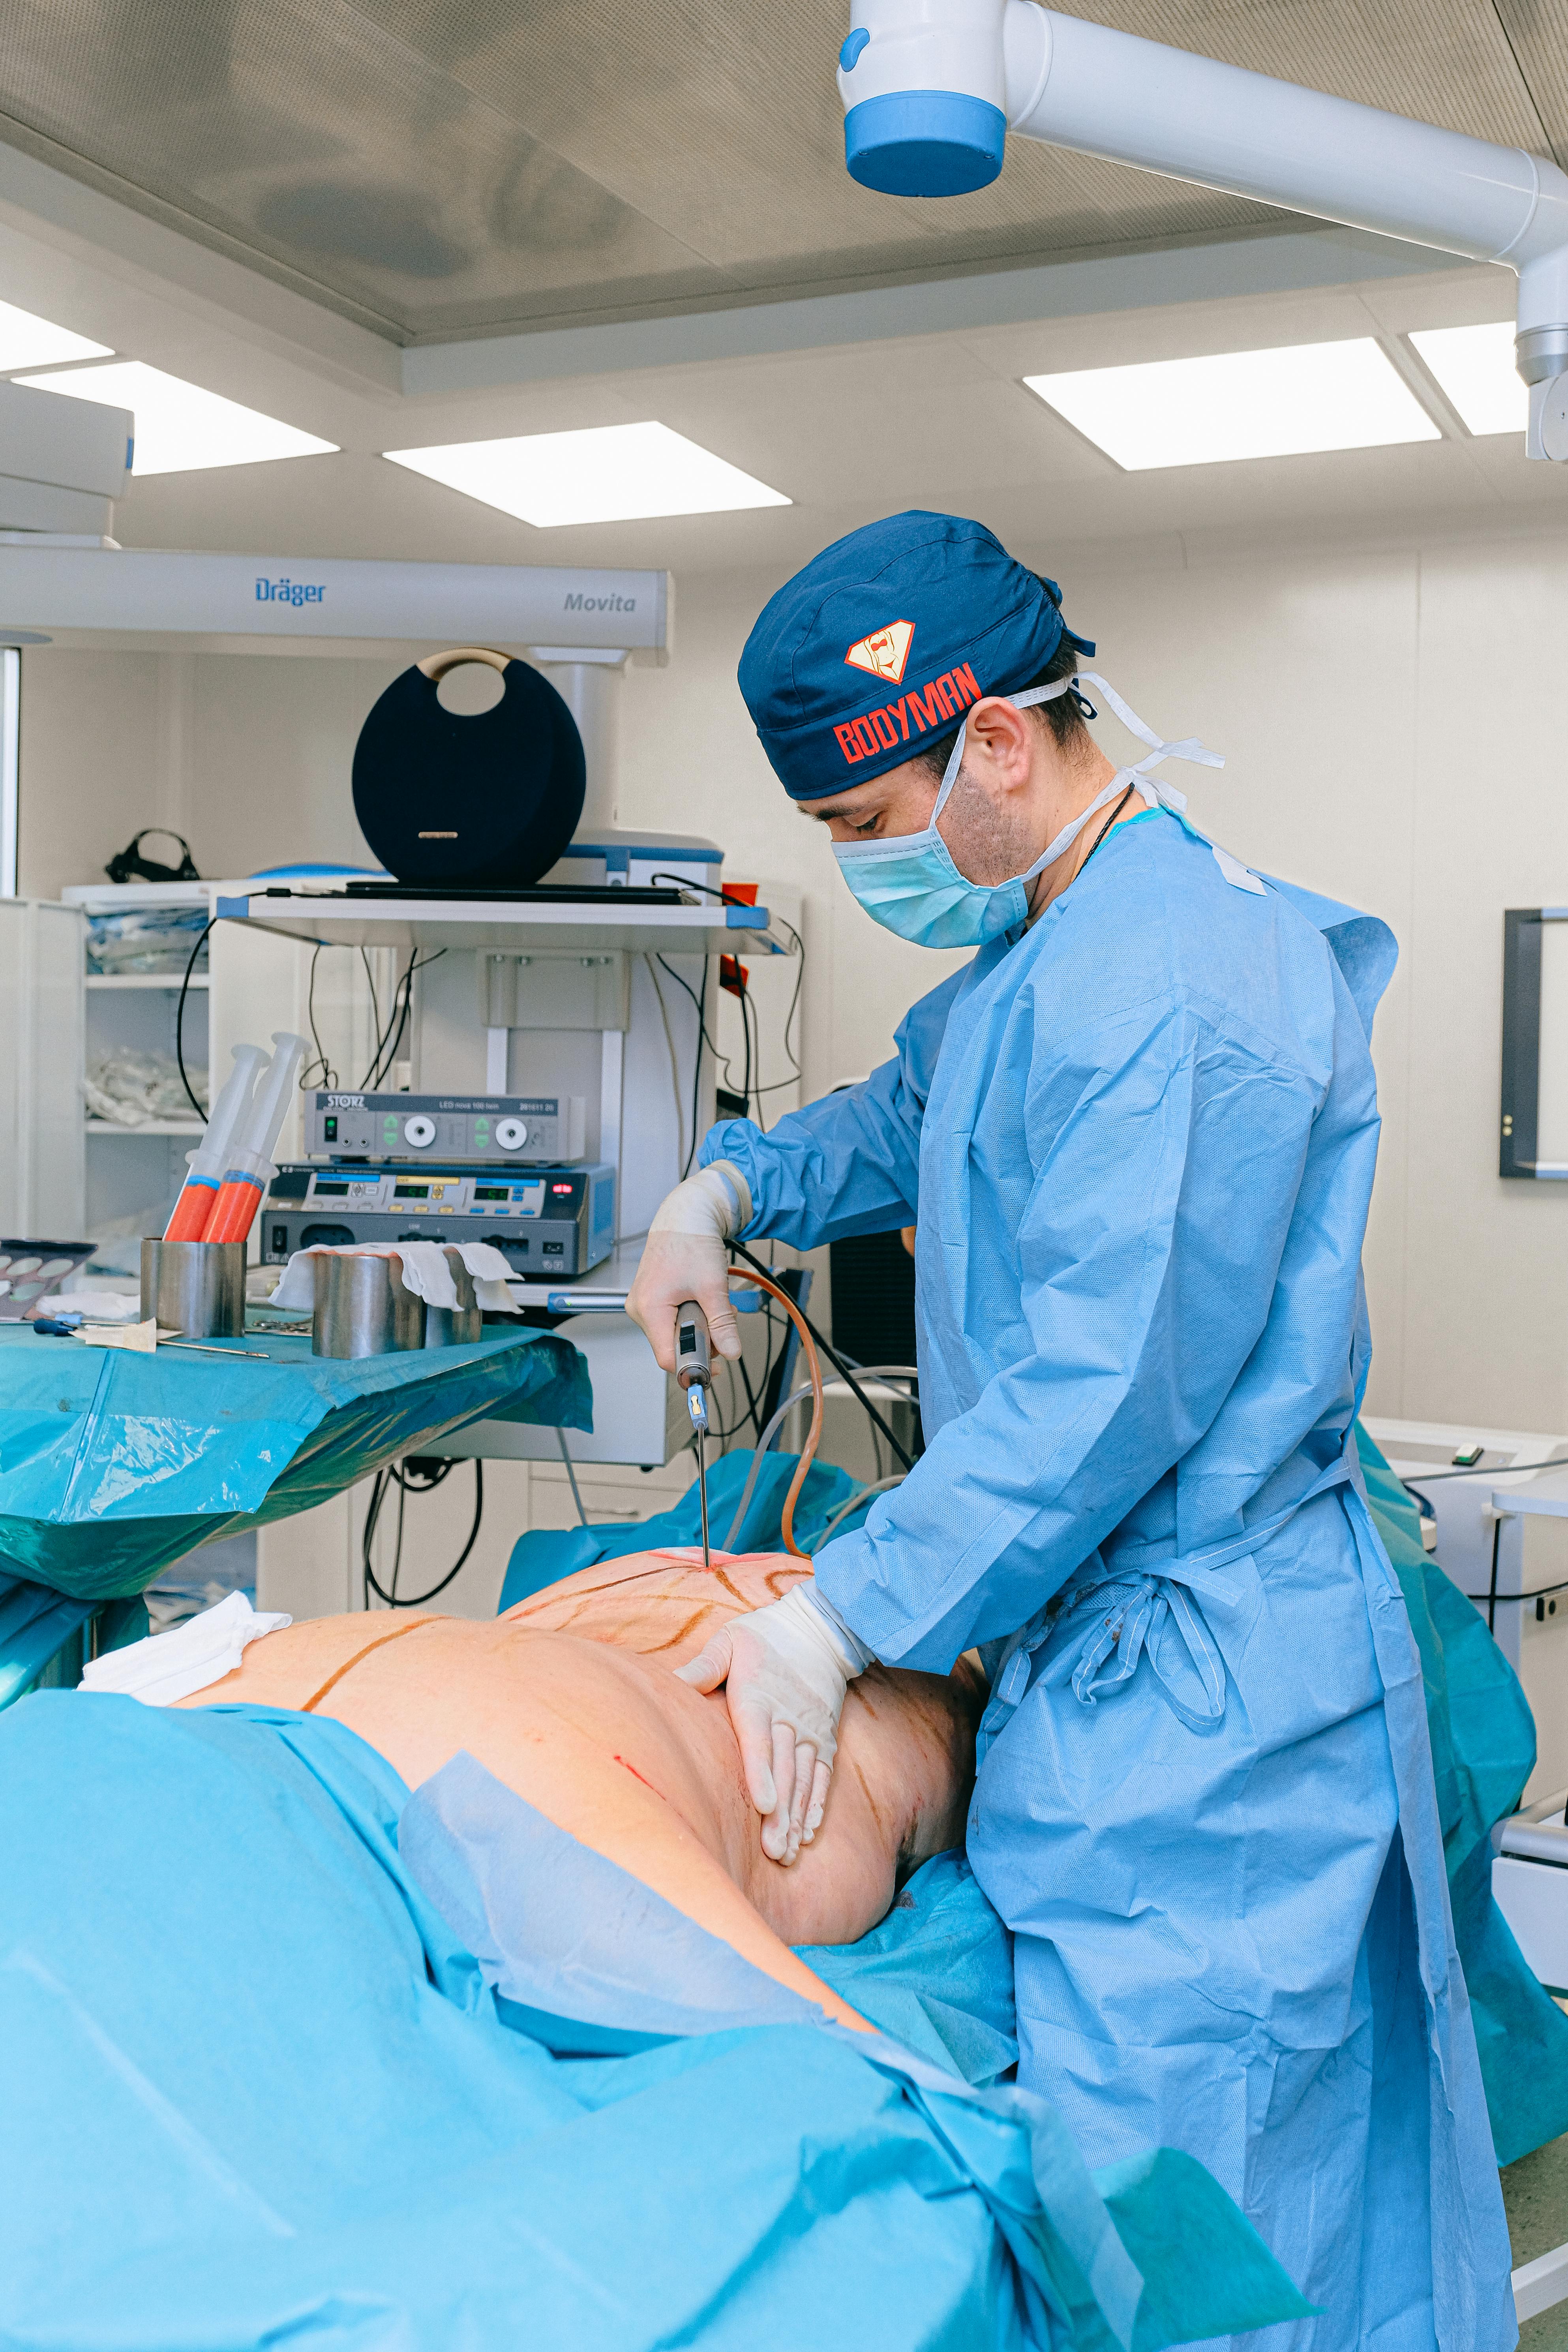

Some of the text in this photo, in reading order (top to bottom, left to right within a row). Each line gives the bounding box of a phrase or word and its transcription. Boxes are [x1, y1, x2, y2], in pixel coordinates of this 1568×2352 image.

[256, 578, 326, 606] Dräger
[564, 593, 636, 611] Movita
[833, 662, 982, 764] BODYMAN
[327, 1095, 365, 1108] STORZ
